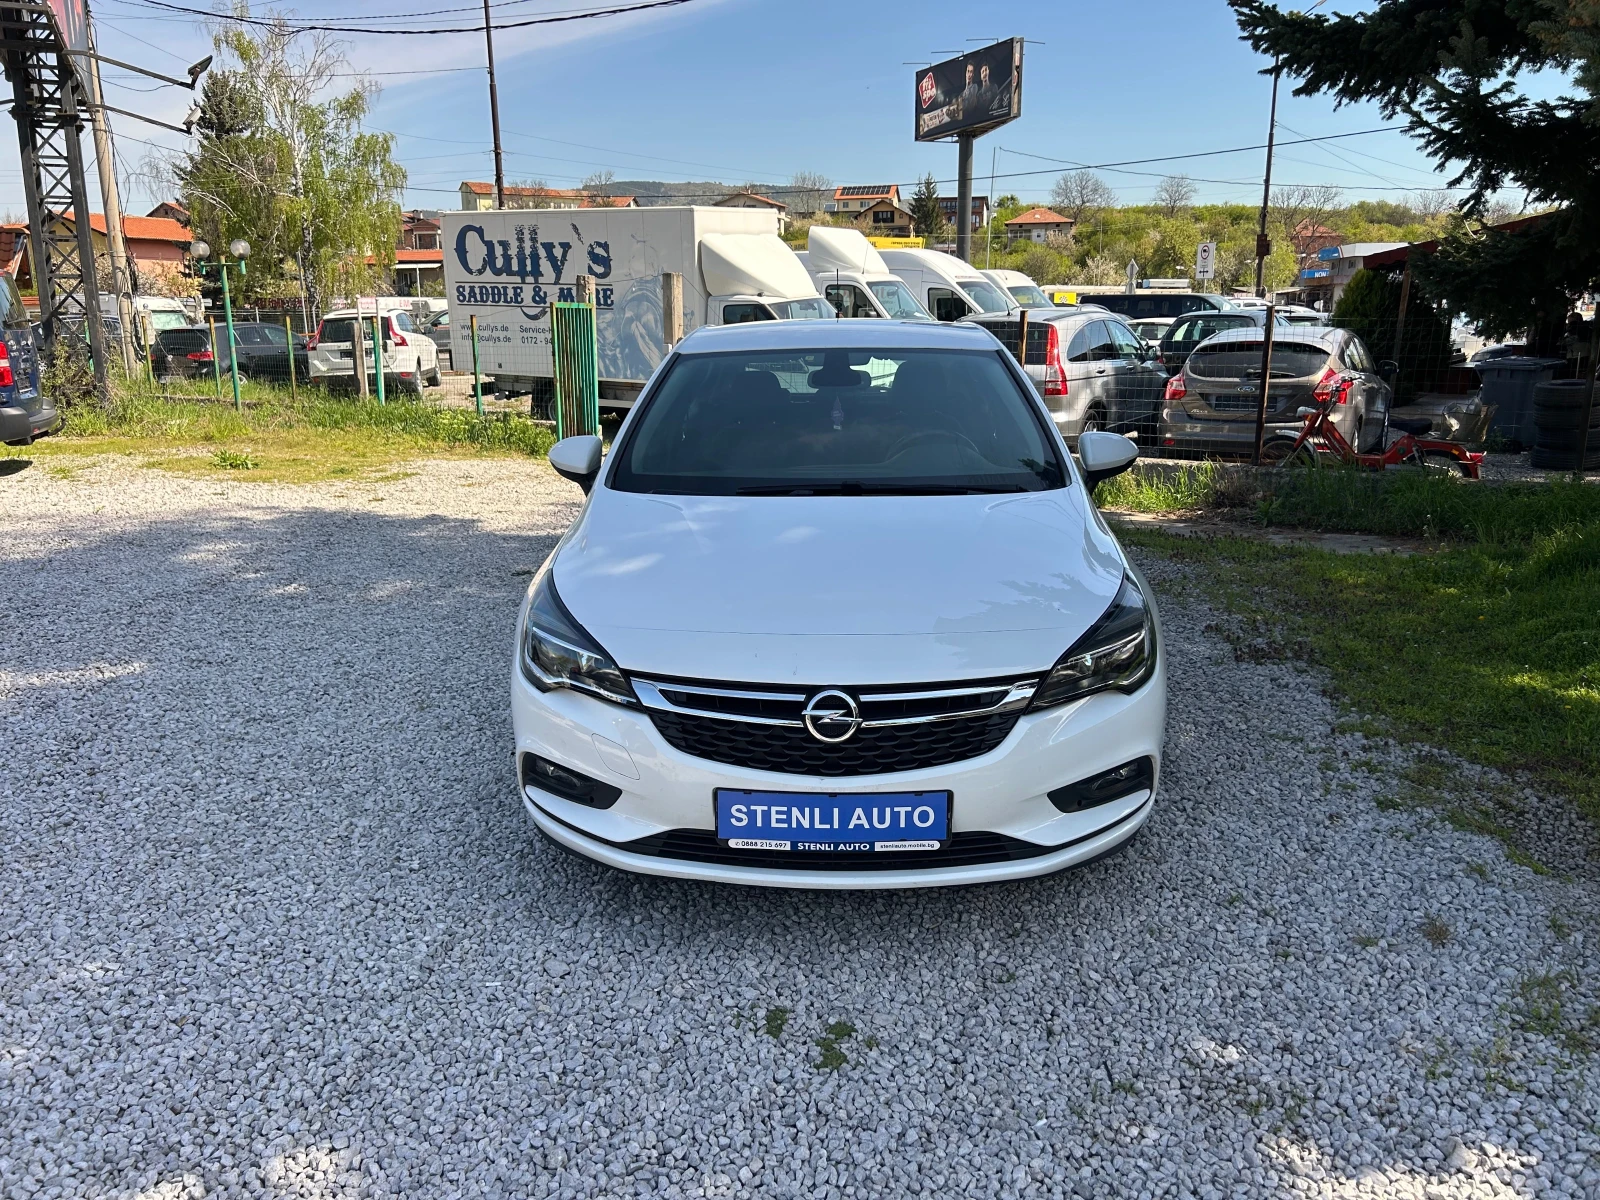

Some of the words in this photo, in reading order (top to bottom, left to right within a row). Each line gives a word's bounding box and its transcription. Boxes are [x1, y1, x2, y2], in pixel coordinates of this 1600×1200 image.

[456, 285, 524, 304] SADDLE
[532, 285, 547, 305] &
[558, 287, 614, 307] MRE
[460, 324, 509, 333] ww.cullys.de
[521, 336, 538, 345] 0172
[730, 804, 838, 828] STENLI
[848, 805, 935, 828] AUTO
[797, 842, 834, 851] STENLI
[837, 842, 869, 851] AUTO
